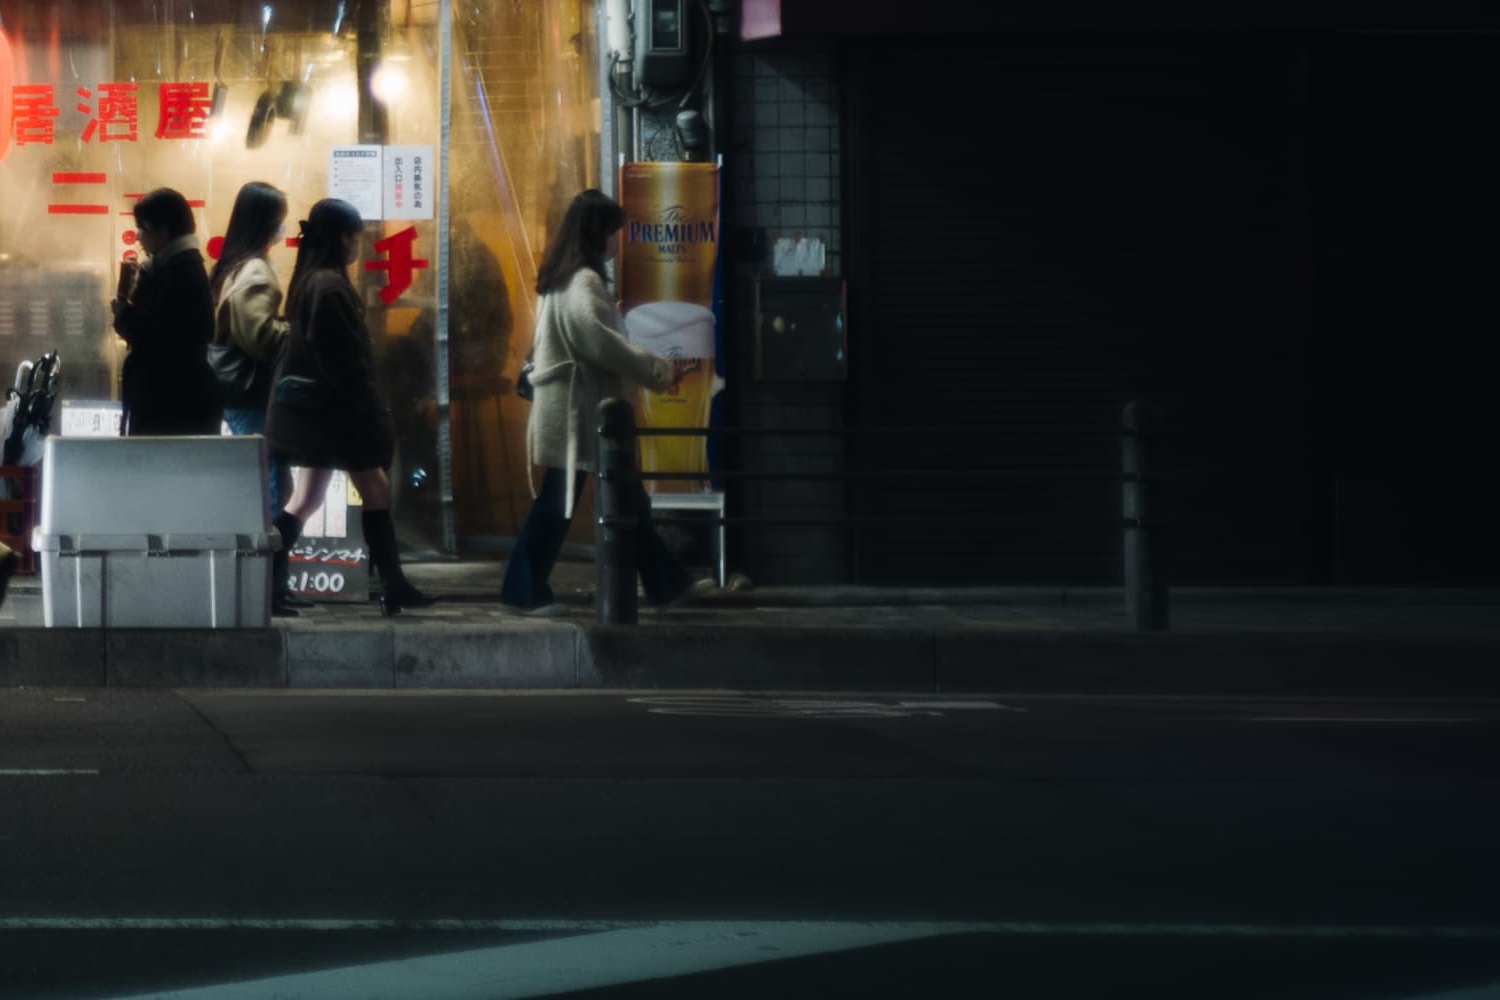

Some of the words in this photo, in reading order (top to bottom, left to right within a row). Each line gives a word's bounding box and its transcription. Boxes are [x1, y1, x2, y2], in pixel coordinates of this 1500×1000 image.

[12, 82, 212, 146] 居酒屋
[628, 220, 716, 244] PREMIUM
